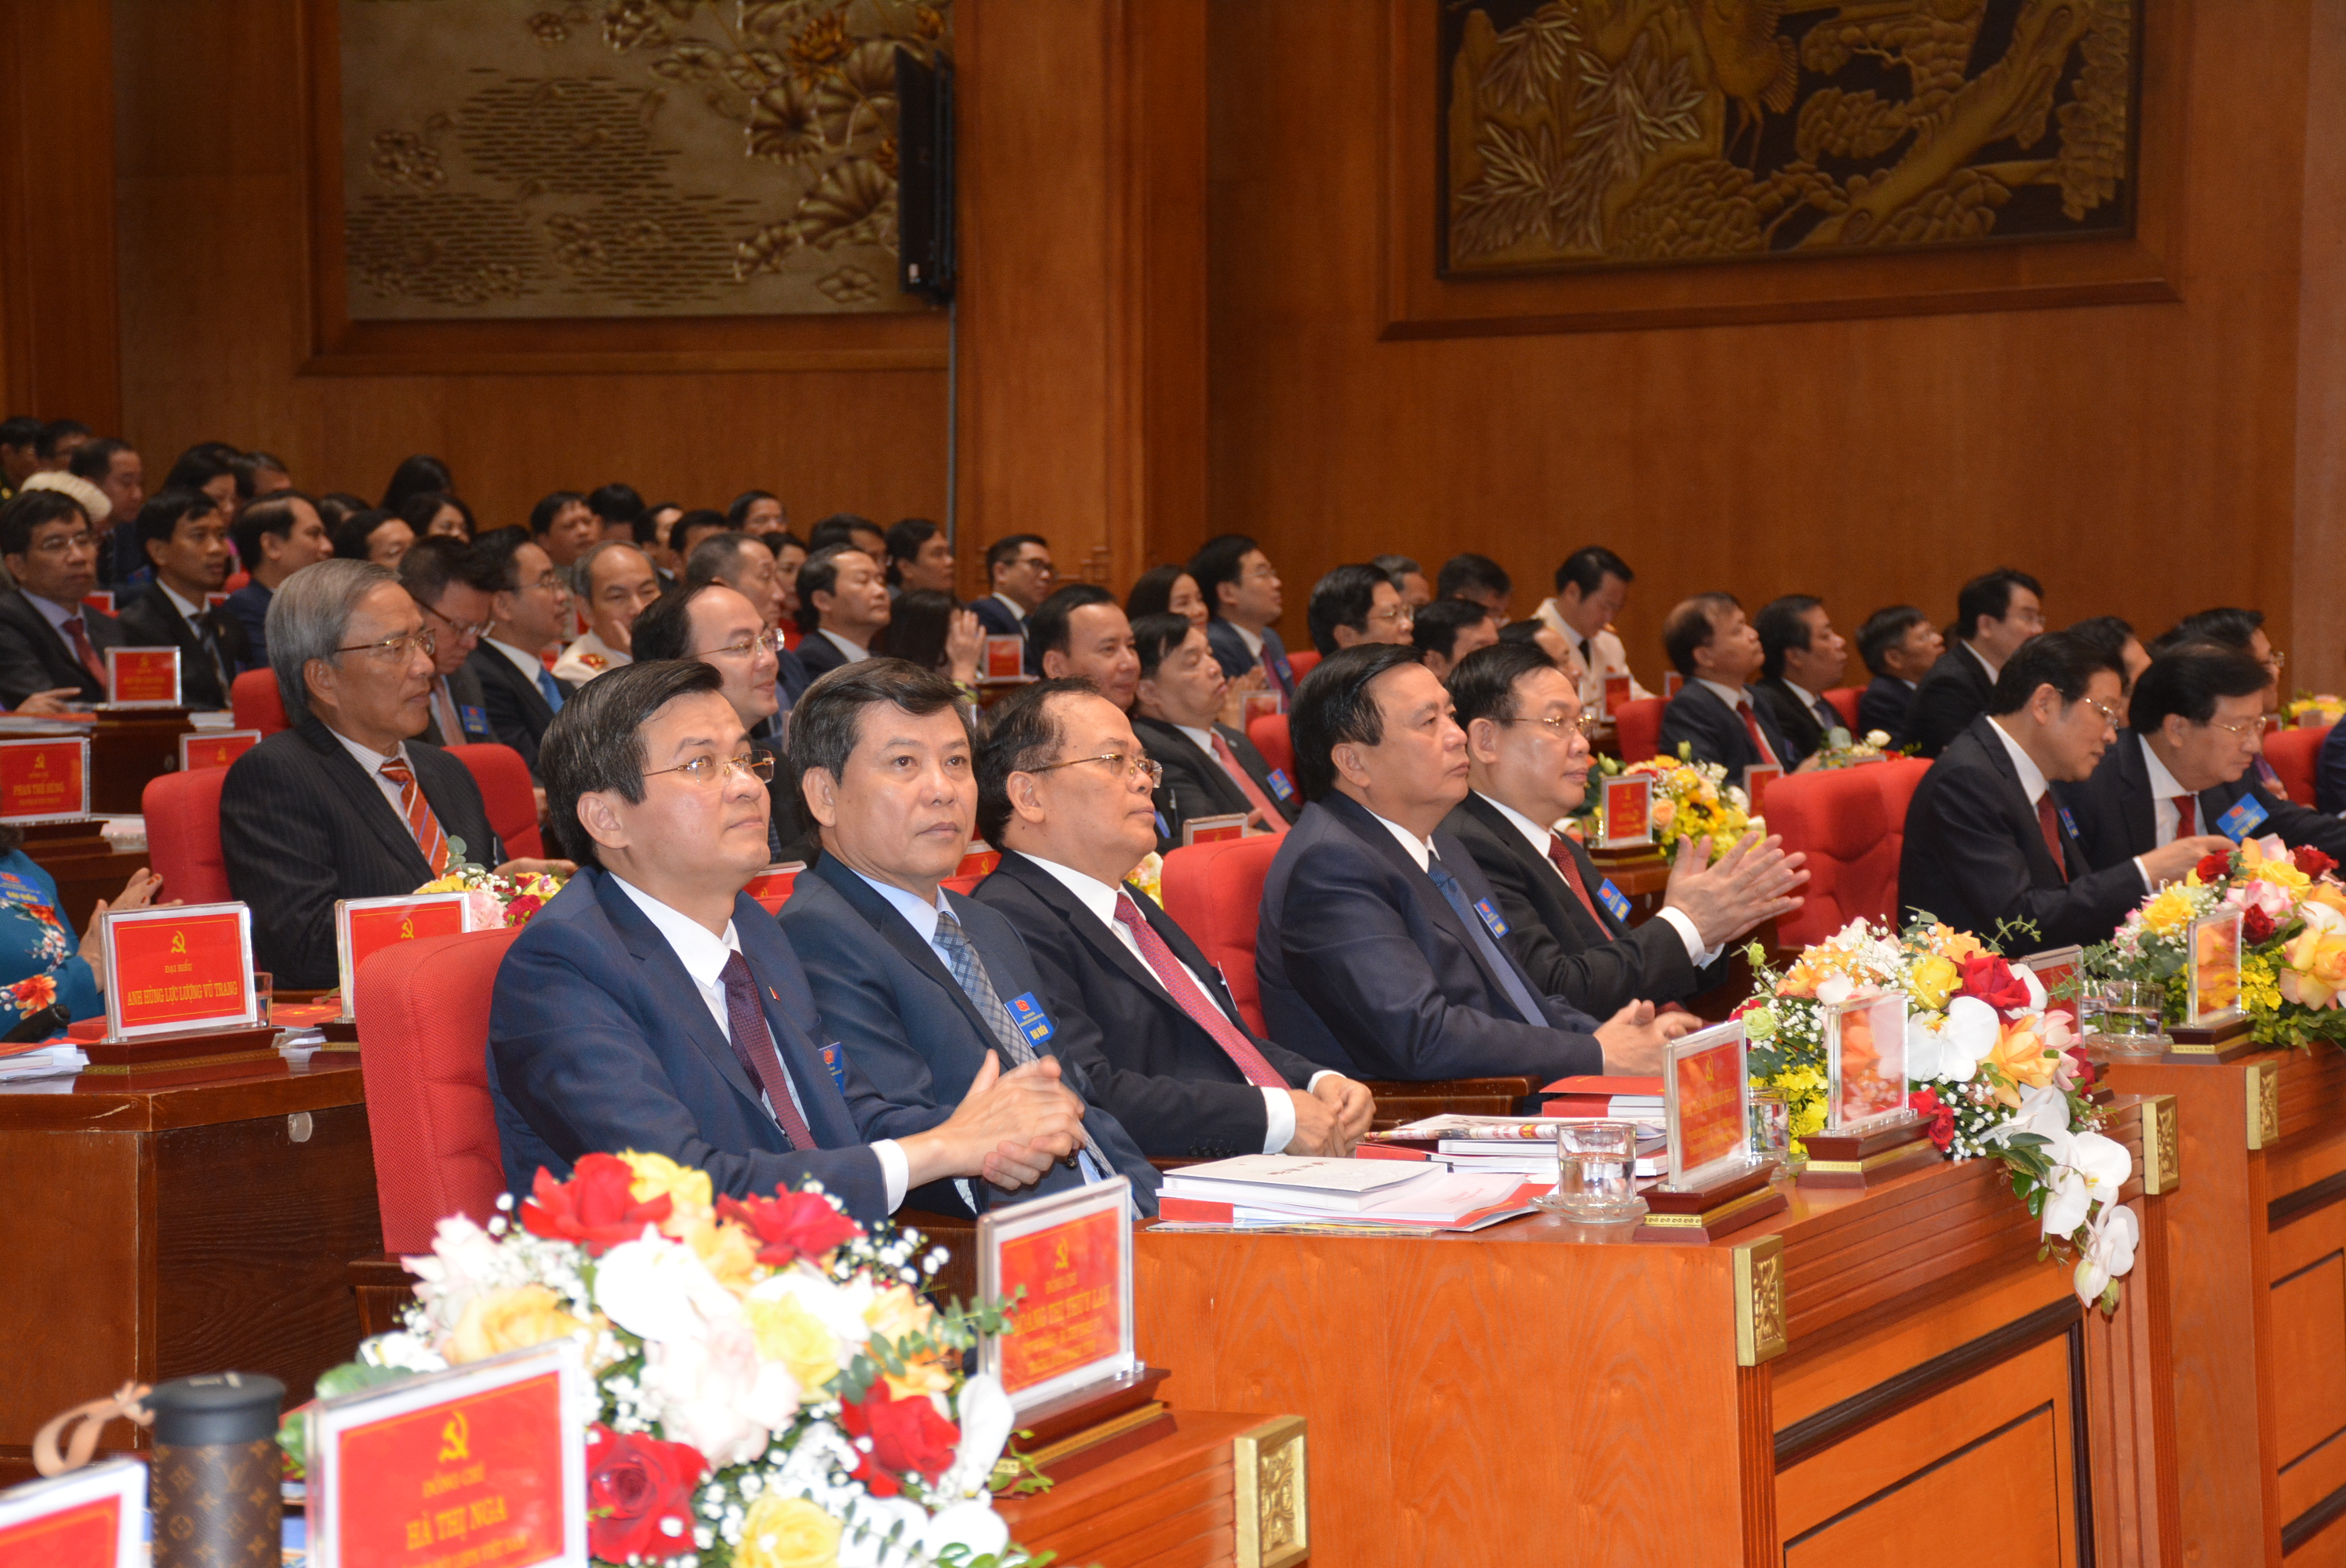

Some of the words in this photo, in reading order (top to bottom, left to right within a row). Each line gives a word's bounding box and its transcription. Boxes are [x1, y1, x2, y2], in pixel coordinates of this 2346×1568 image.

[165, 964, 176, 975] ĐẠI
[178, 959, 193, 972] BIỂU
[128, 991, 143, 1006] ANH
[144, 985, 165, 1004] HÙNG
[165, 985, 179, 1005] LỰC
[180, 984, 203, 1004] LƯỢNG
[214, 981, 238, 997] TRANG
[1030, 1029, 1040, 1040] ĐẠI
[1036, 1022, 1049, 1036] BIỂU
[422, 1472, 459, 1499] ĐỒNG
[460, 1461, 485, 1486] CHÍ
[406, 1510, 434, 1551] HÀ
[435, 1508, 467, 1541] THỊ
[469, 1495, 507, 1530] NGA
